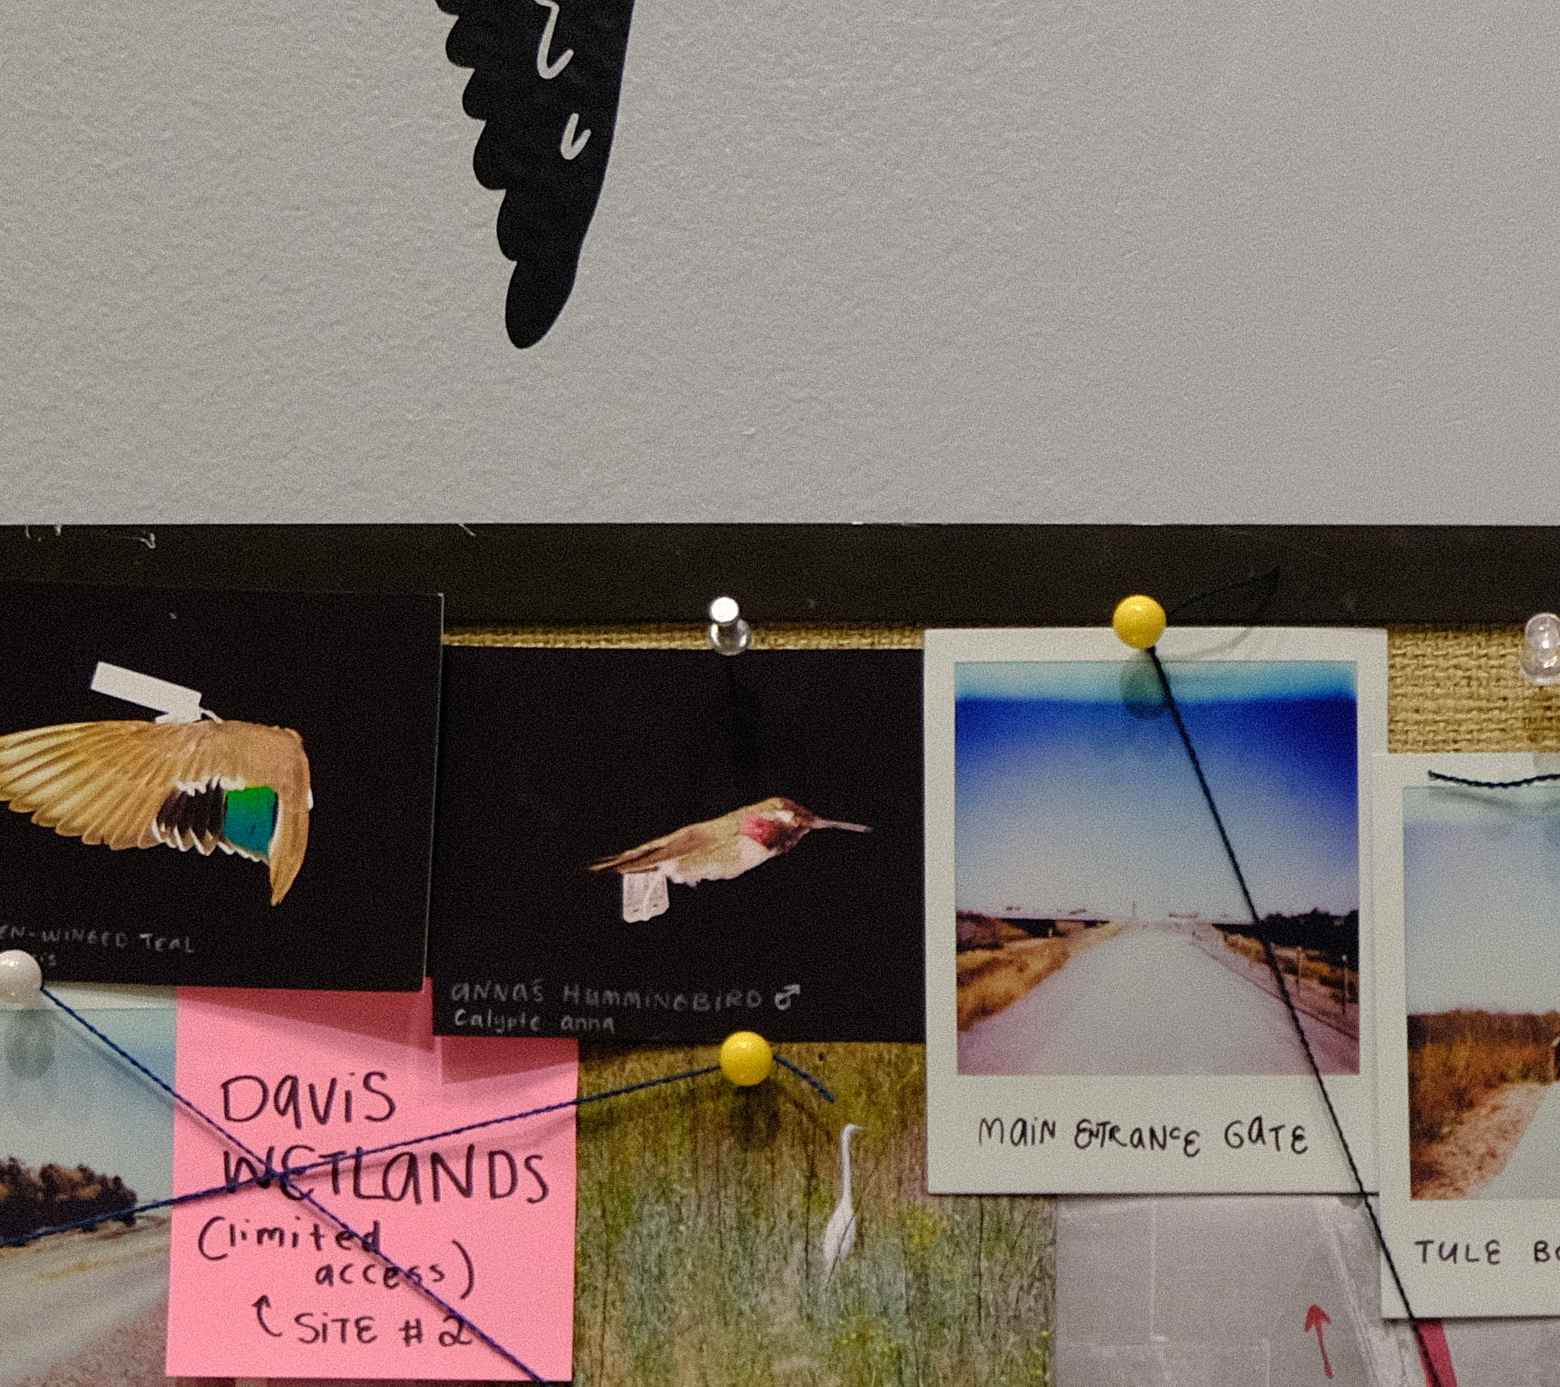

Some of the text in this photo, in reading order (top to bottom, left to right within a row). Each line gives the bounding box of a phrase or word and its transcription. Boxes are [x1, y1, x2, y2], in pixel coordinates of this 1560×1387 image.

[198, 1215, 381, 1262] (limited
[1415, 1238, 1501, 1266] TULE
[316, 1242, 475, 1300] access)
